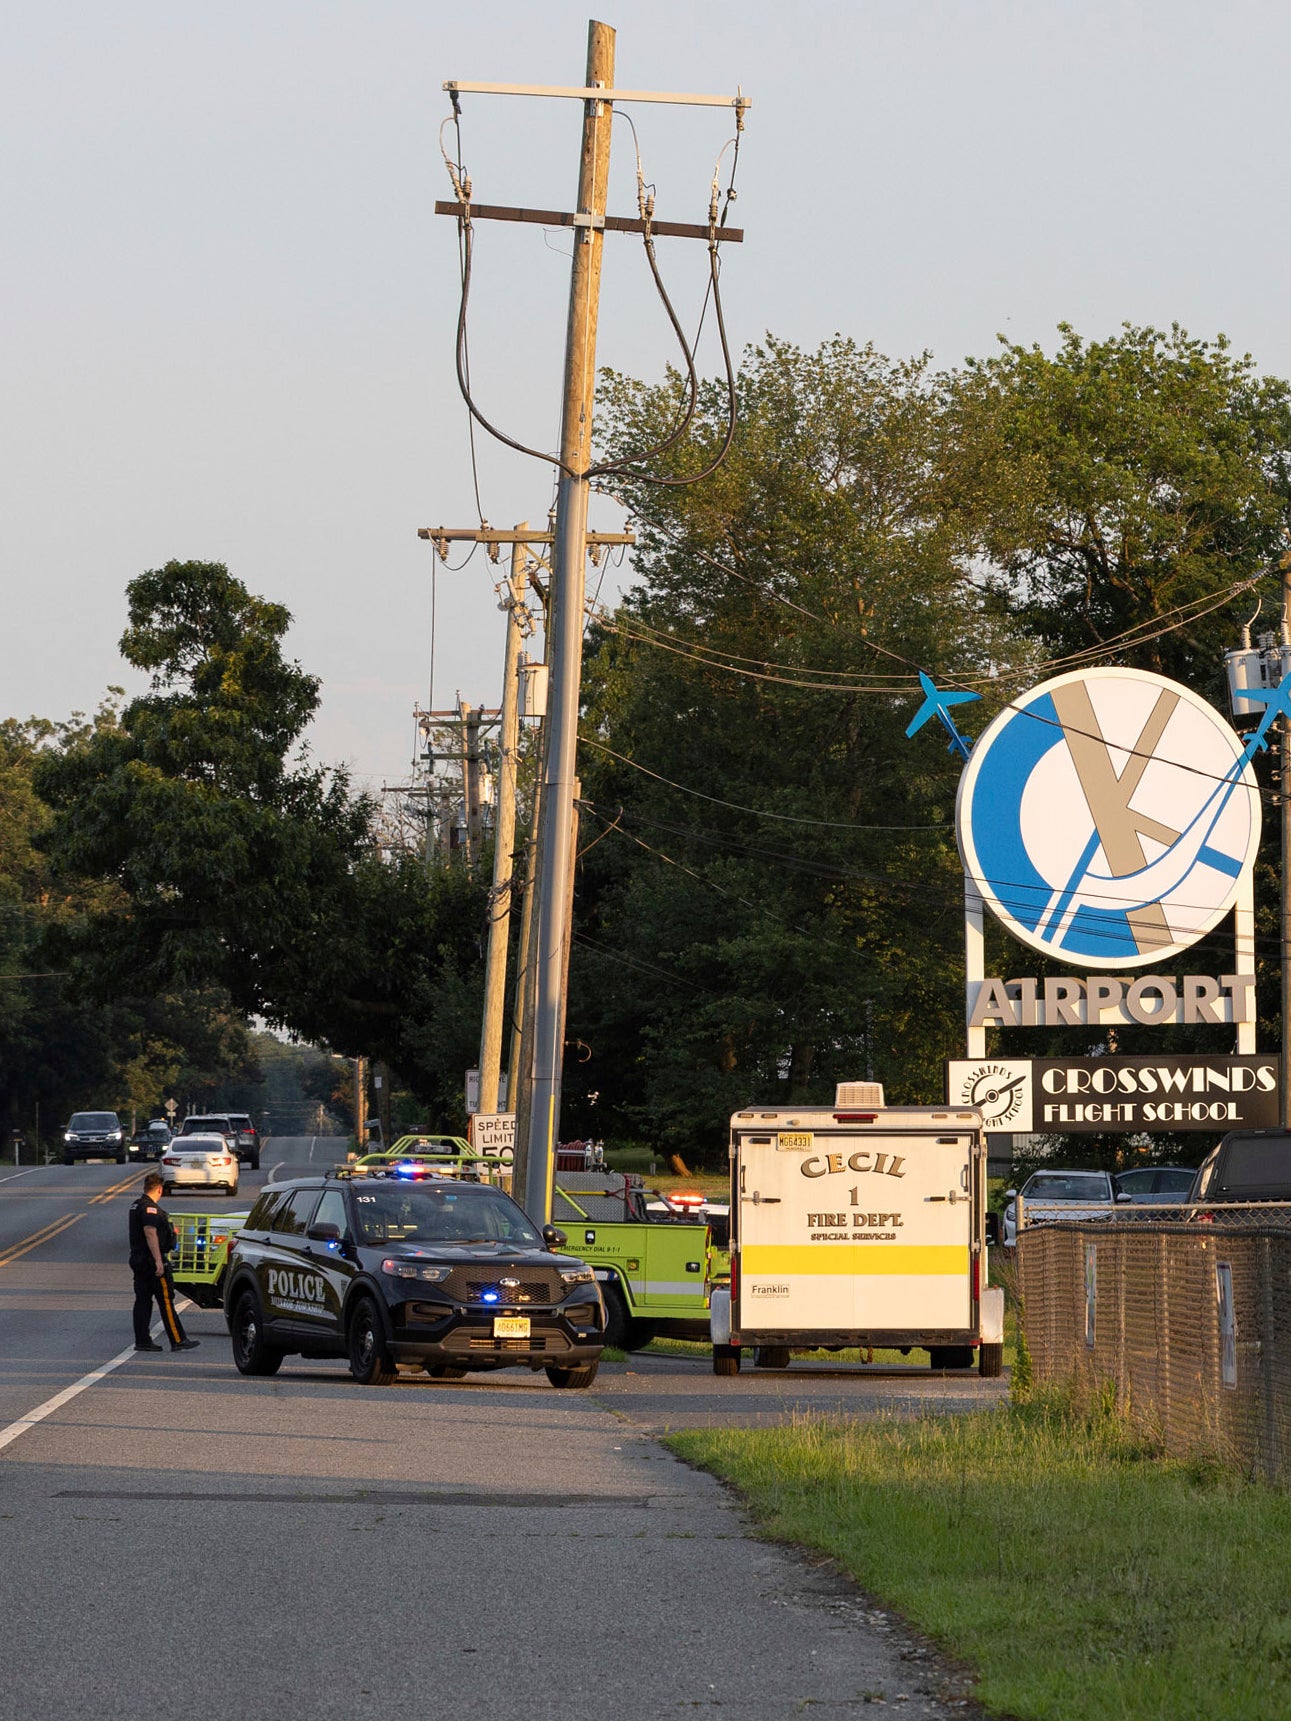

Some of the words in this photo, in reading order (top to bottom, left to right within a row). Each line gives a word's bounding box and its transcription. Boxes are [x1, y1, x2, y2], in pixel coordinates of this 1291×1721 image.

[968, 974, 1256, 1027] AIRPORT
[960, 1065, 1012, 1105] CROSSWINDS
[1041, 1065, 1277, 1095] CROSSWINDS
[1004, 1087, 1023, 1121] SCHOOL
[1043, 1103, 1137, 1123] FLIGHT
[1142, 1102, 1244, 1122] SCHOOL
[482, 1133, 514, 1144] LIMIT
[482, 1145, 514, 1167] 50
[800, 1151, 907, 1179] CECIL
[848, 1185, 860, 1206] 1
[806, 1212, 848, 1228] FIRE
[852, 1212, 905, 1227] DEPT.
[810, 1232, 850, 1241] SPECIAL
[852, 1232, 897, 1241] SERVICES
[267, 1268, 325, 1303] POLICE
[751, 1284, 789, 1294] Franklin
